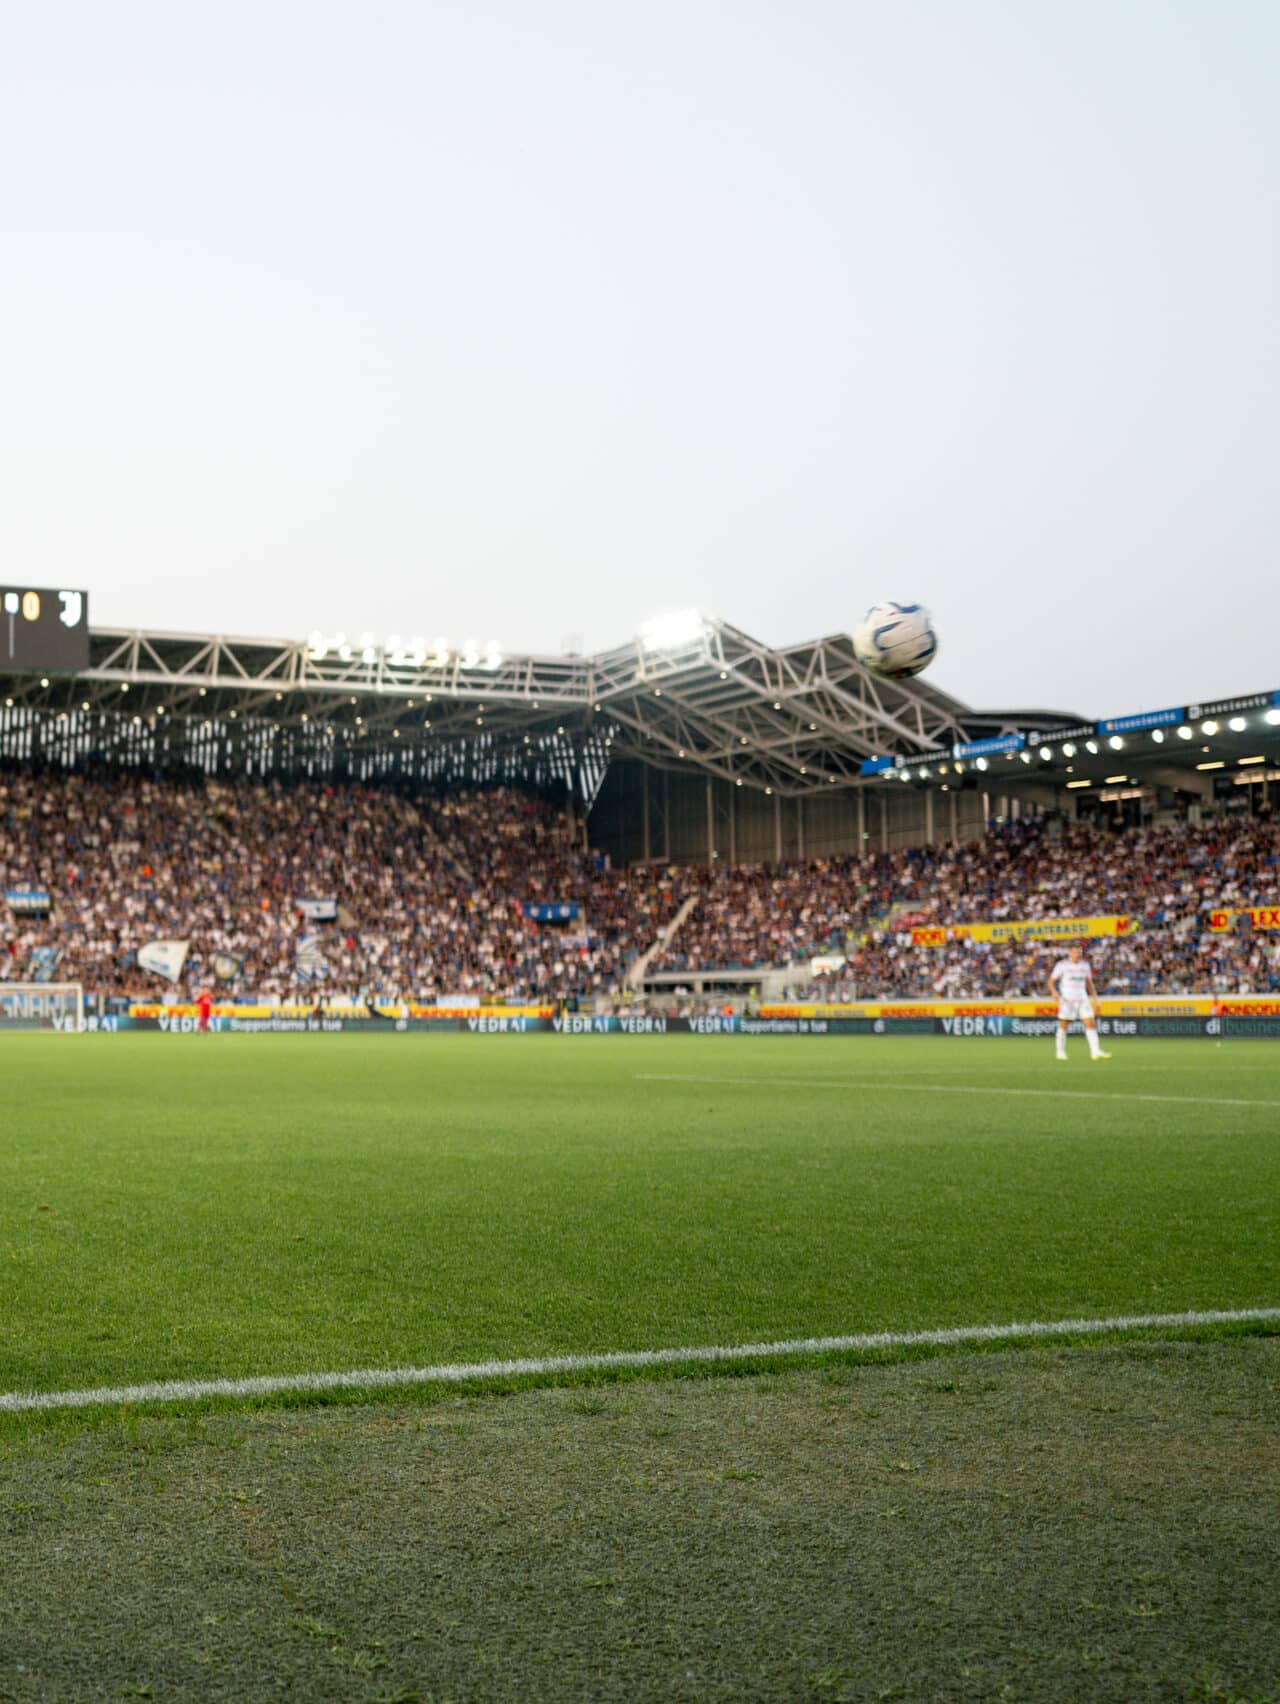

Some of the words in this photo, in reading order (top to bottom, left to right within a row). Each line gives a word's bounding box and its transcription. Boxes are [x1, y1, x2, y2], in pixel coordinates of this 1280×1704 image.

[469, 1017, 526, 1033] VEDRAI
[552, 1017, 609, 1033] VEDRAI
[620, 1017, 667, 1033] VEDRAI
[688, 1017, 735, 1033] VEDRAI
[942, 1017, 1003, 1035] VEDRAI
[1113, 1018, 1137, 1034] tue
[1206, 1015, 1221, 1034] di
